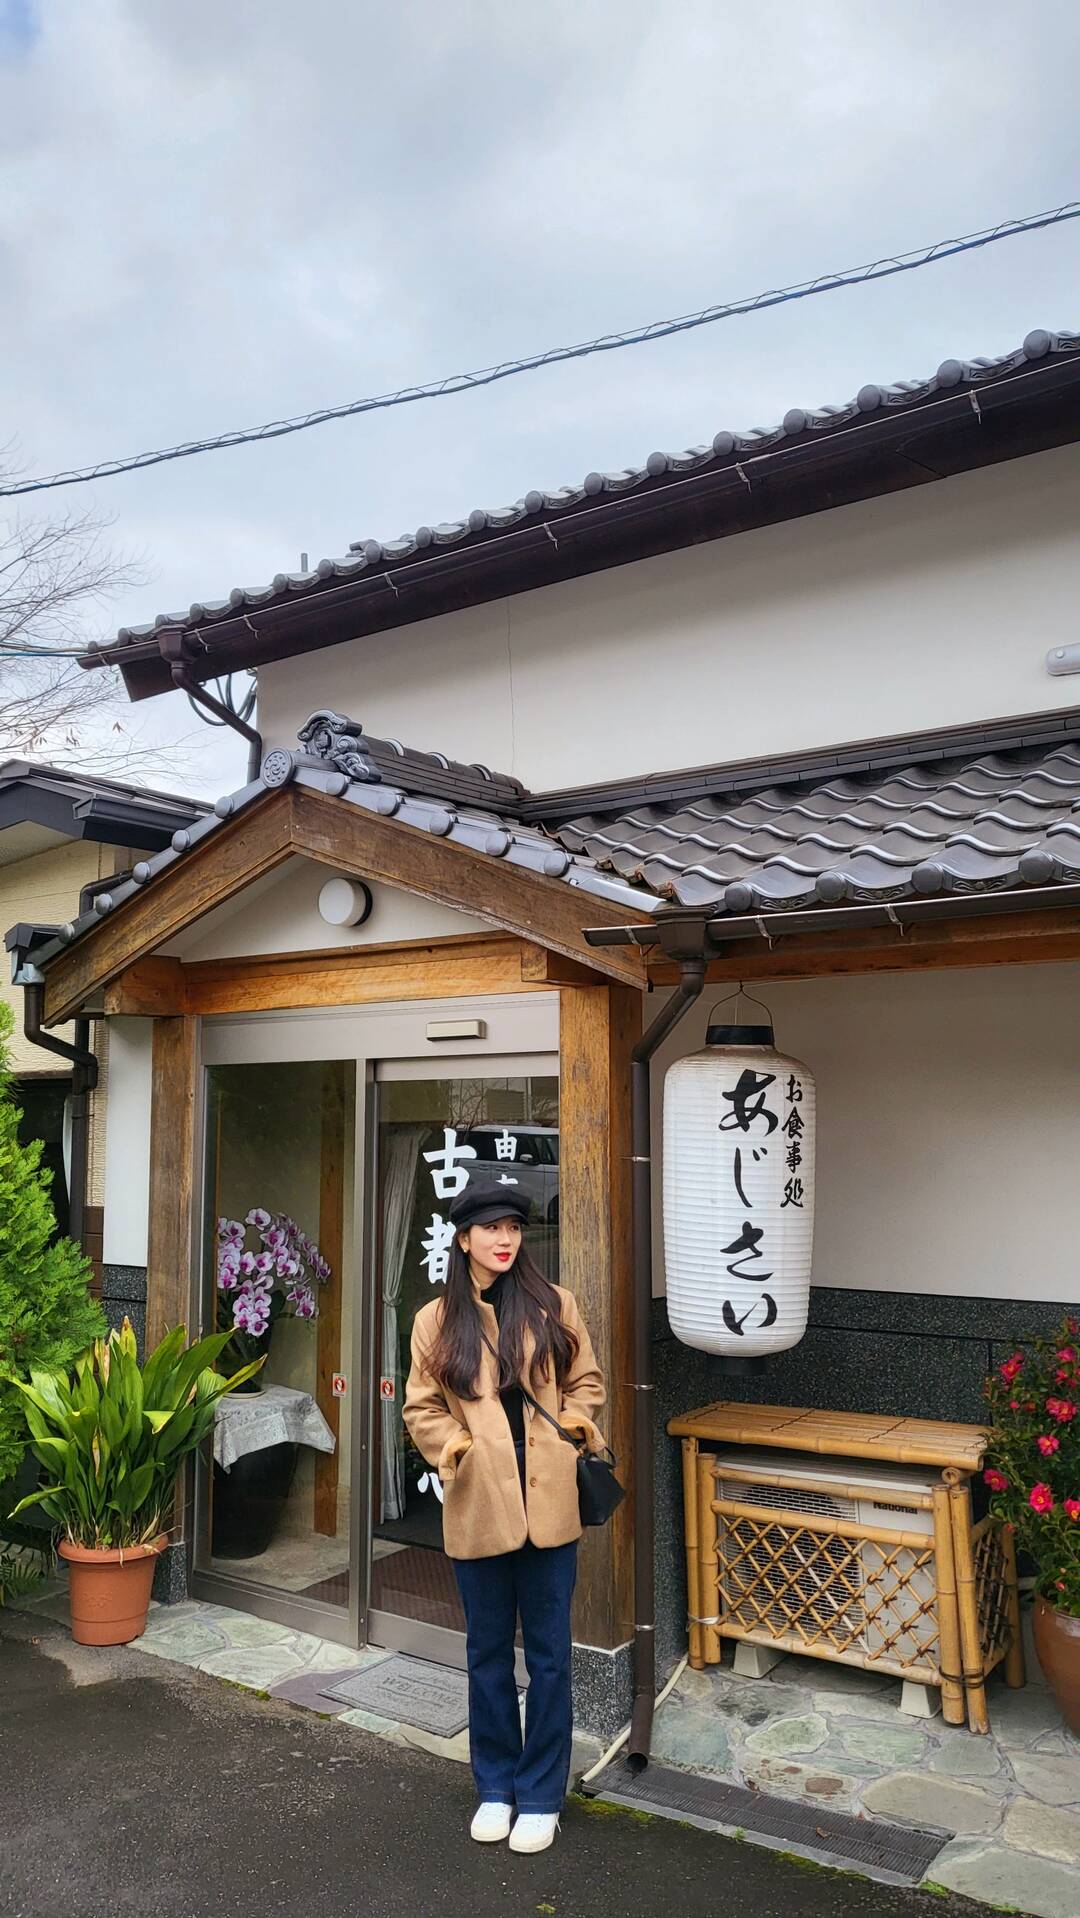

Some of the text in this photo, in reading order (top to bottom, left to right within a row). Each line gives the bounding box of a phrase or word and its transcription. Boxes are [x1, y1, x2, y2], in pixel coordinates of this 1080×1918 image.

[718, 1068, 780, 1337] あじさい
[780, 1073, 805, 1208] お食事処
